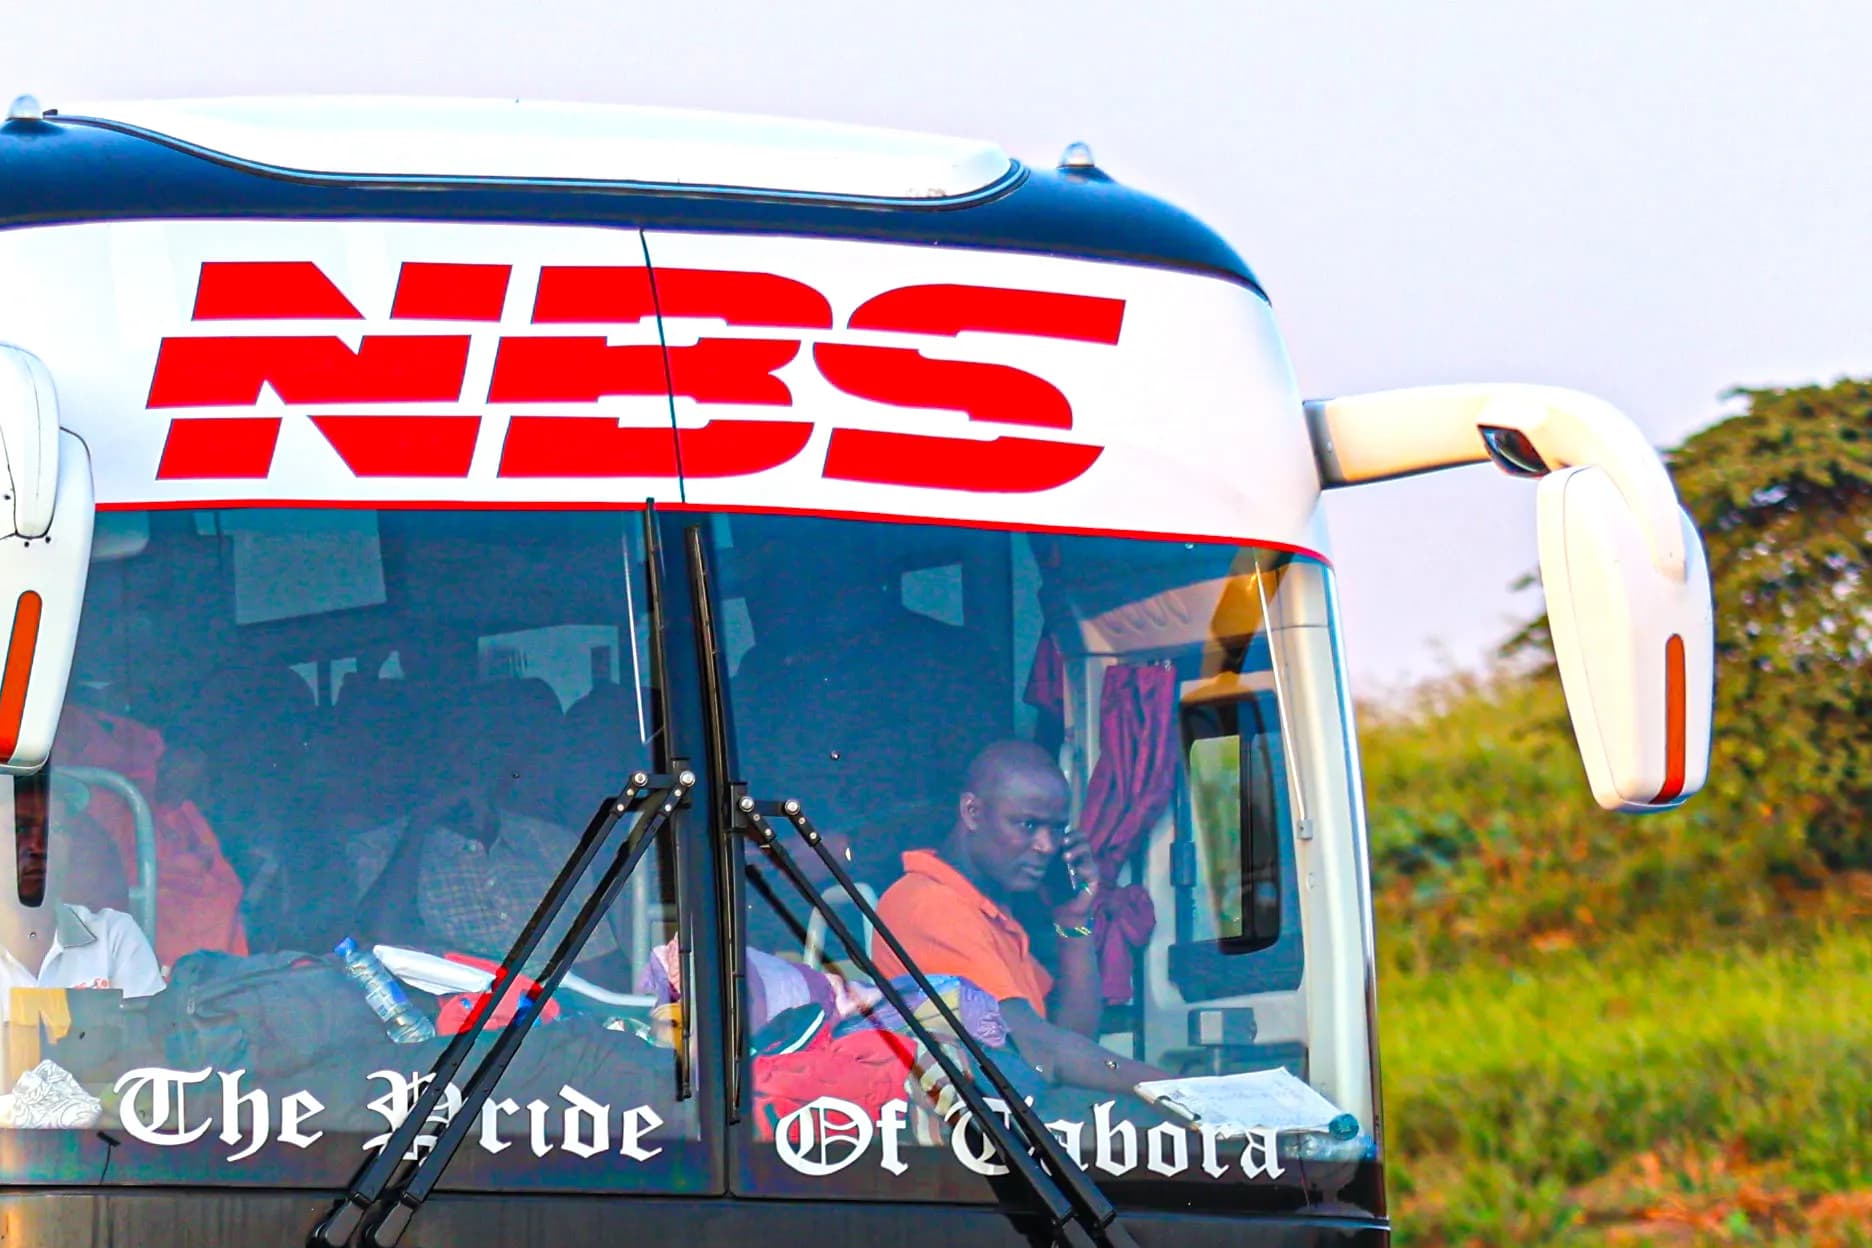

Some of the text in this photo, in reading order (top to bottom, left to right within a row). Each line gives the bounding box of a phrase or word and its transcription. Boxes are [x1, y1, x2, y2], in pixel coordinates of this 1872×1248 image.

[146, 260, 1127, 494] NBS
[112, 1066, 326, 1163] The
[774, 1096, 909, 1177] Of
